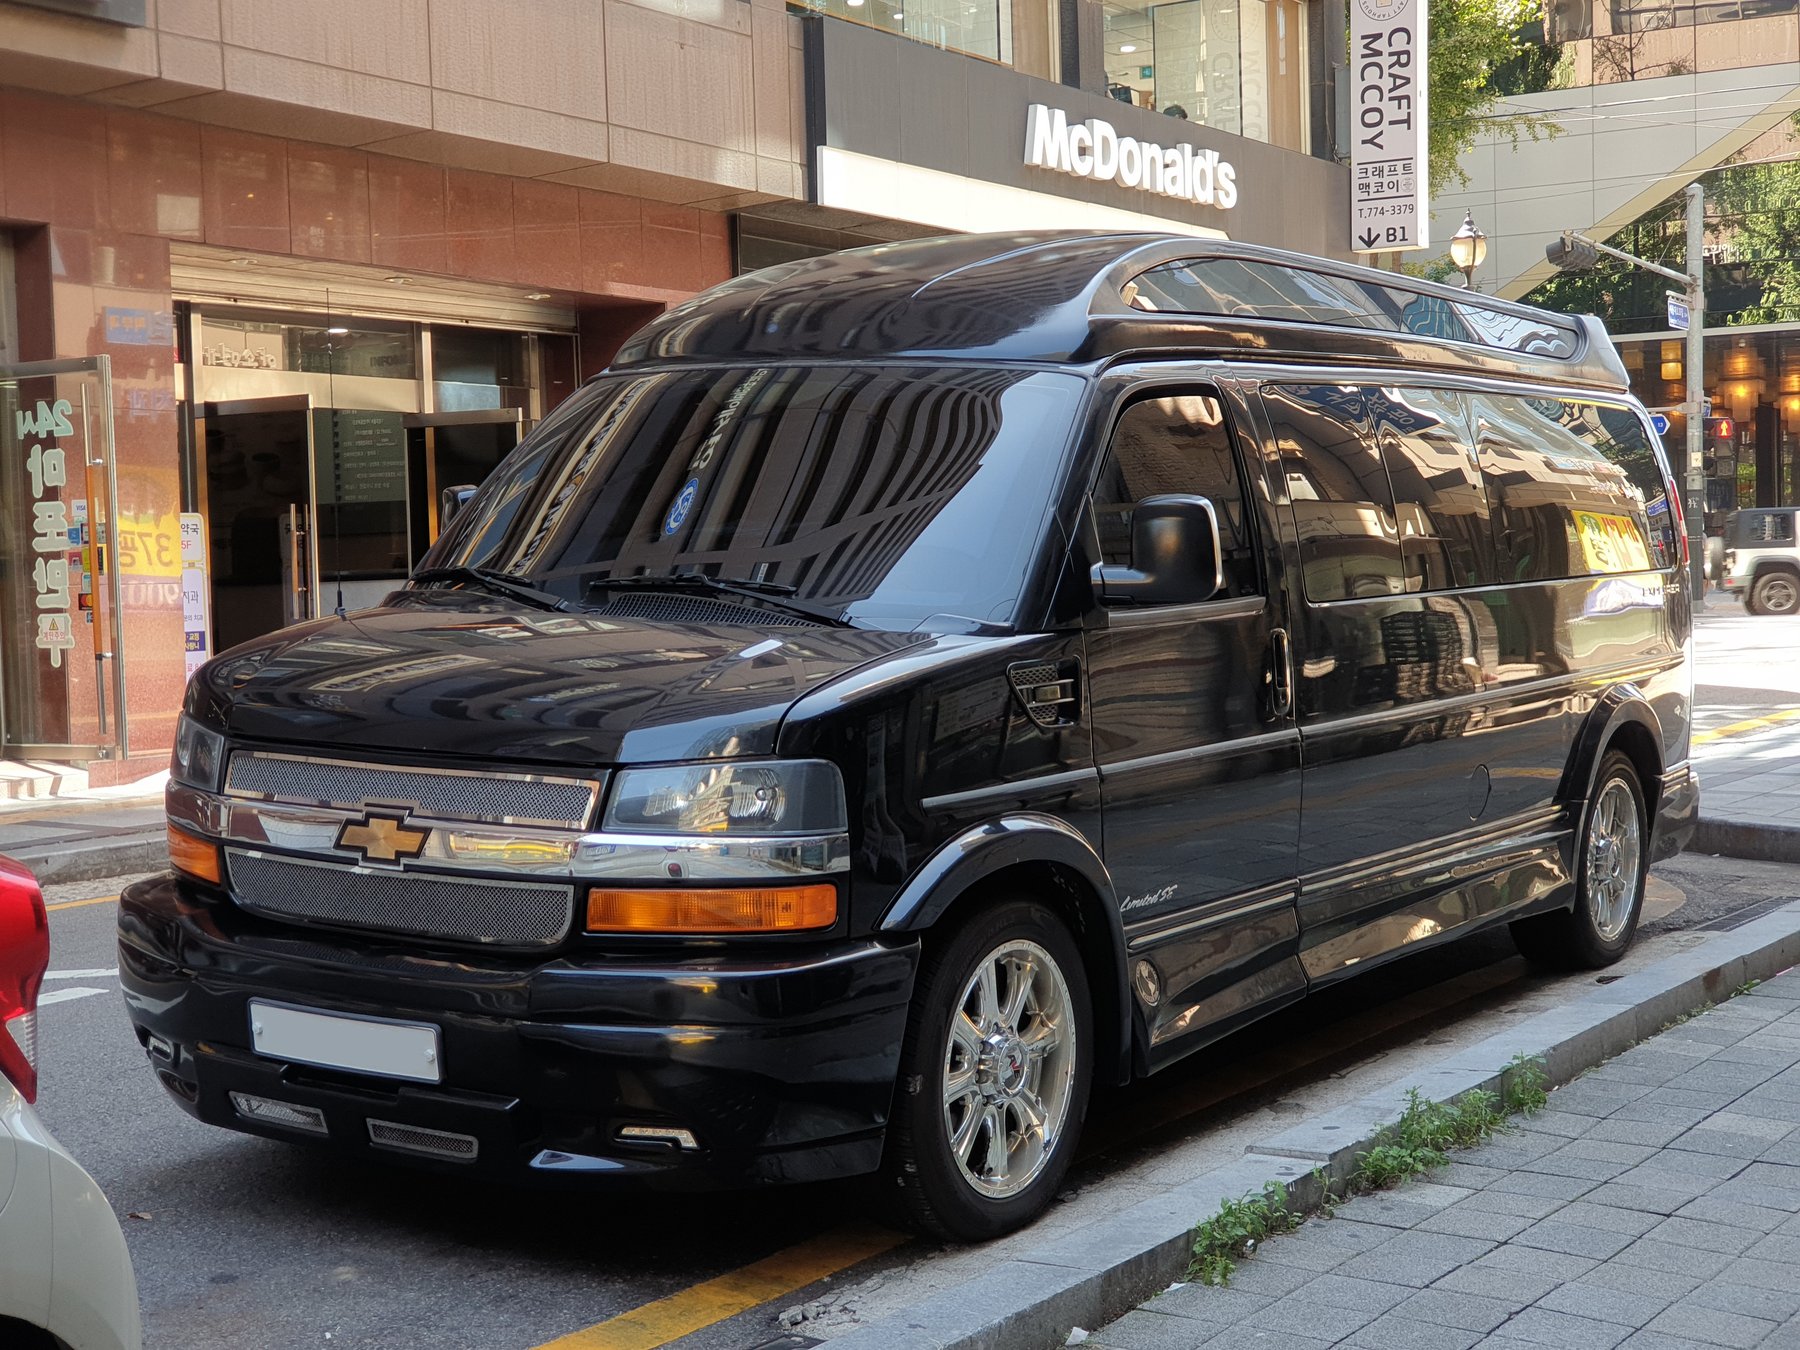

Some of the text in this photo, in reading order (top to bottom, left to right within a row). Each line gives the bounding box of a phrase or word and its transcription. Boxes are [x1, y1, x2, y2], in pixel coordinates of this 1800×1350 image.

[1387, 26, 1412, 131] CRAFT
[1360, 32, 1385, 151] MCCOY
[1024, 103, 1238, 210] McDonald's
[1357, 162, 1414, 180] 크래프트
[1358, 179, 1399, 197] 맥코이
[1358, 203, 1414, 219] T.774-3379
[1386, 226, 1408, 243] B1
[75, 504, 87, 512] VISA
[180, 523, 200, 535] 약국
